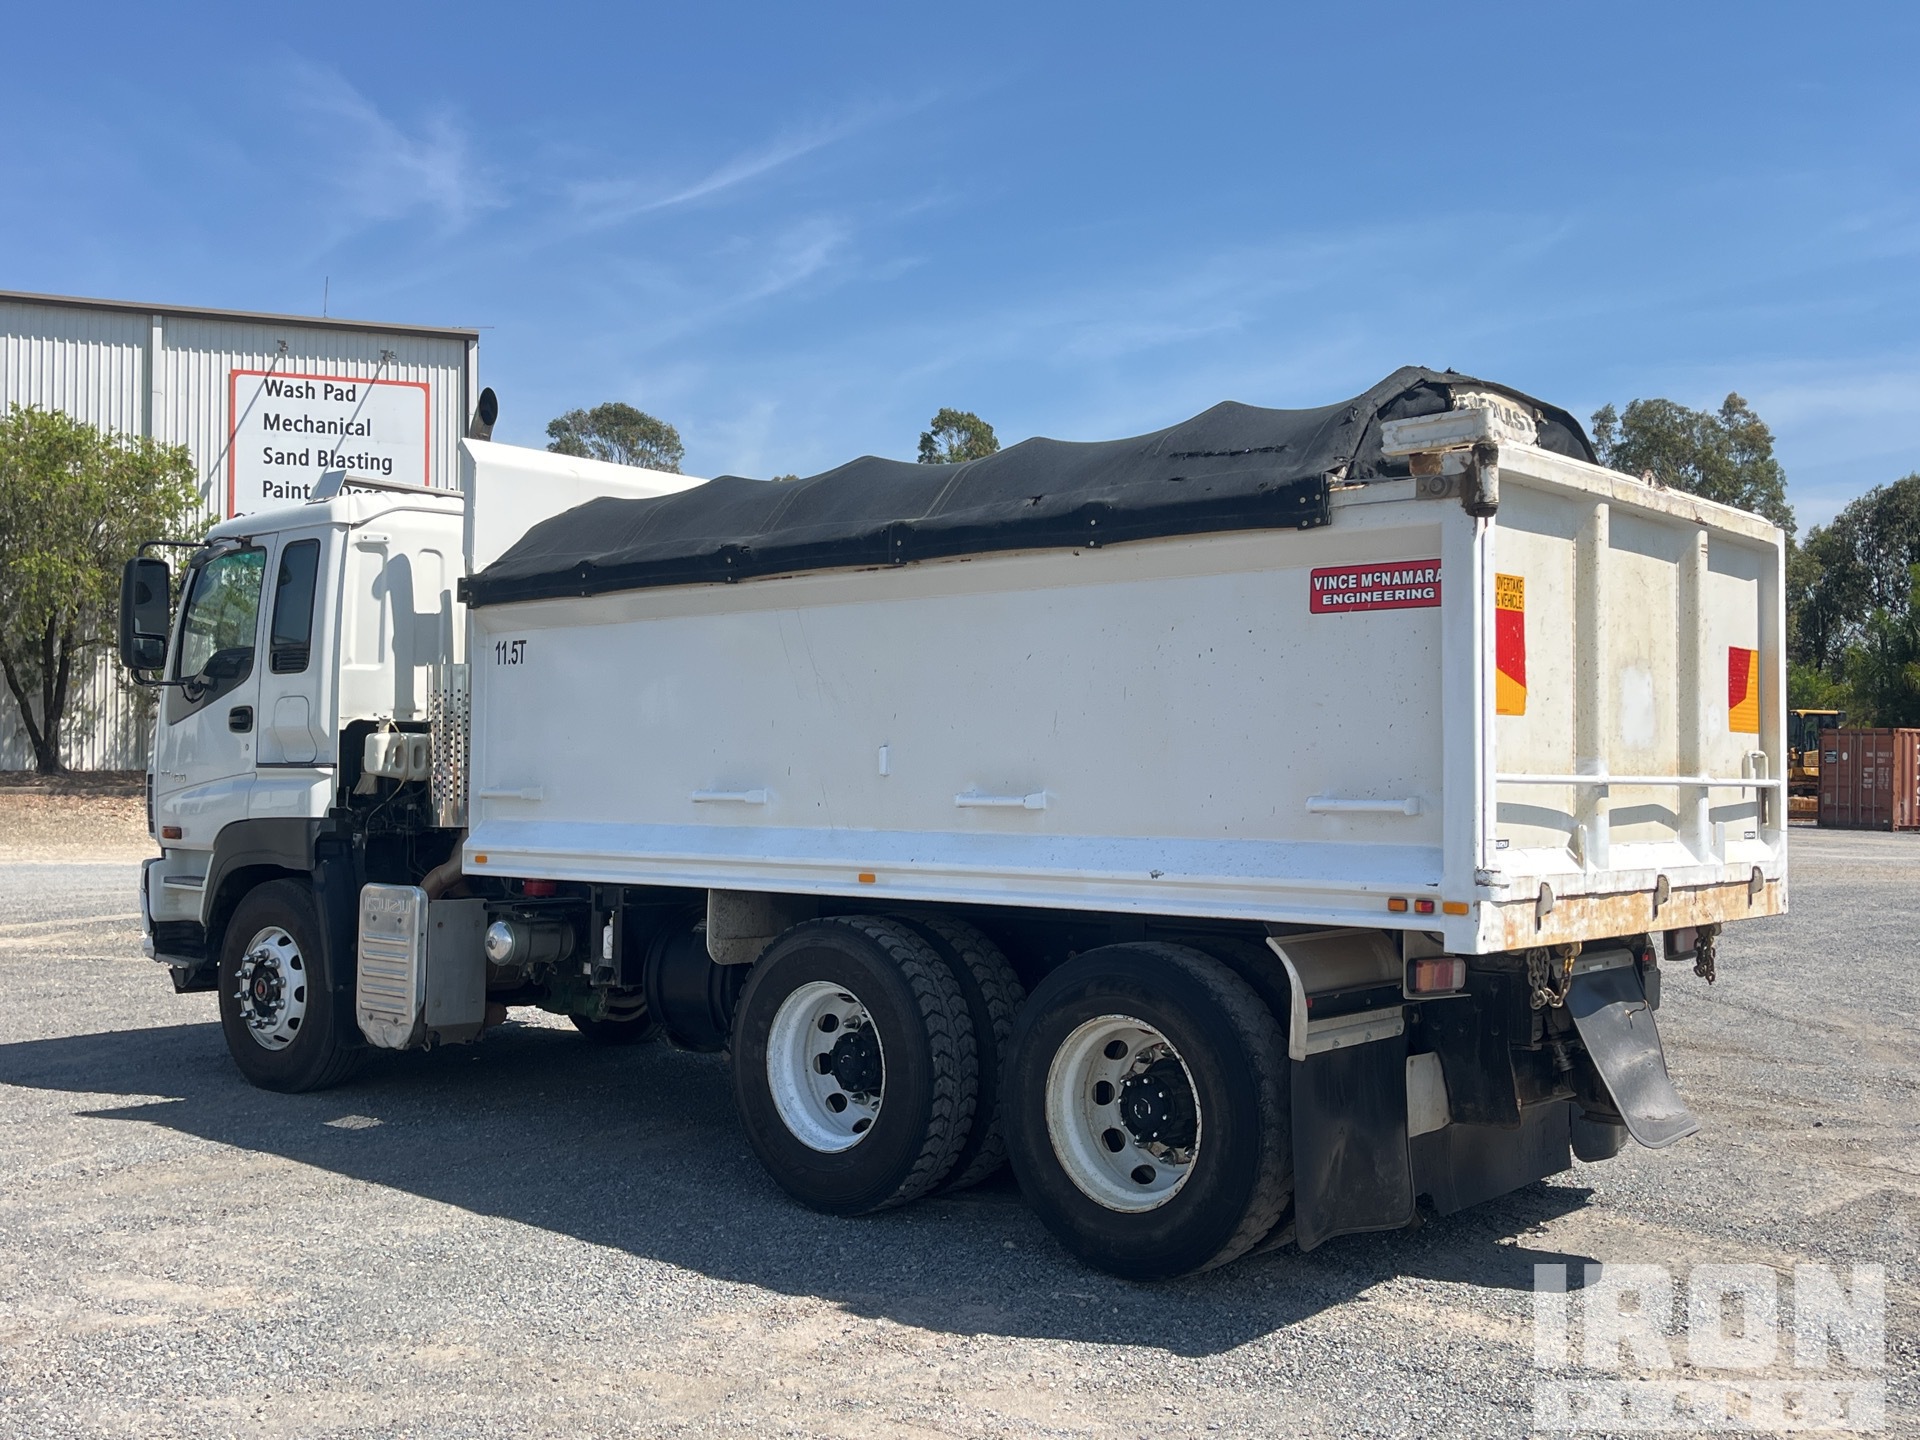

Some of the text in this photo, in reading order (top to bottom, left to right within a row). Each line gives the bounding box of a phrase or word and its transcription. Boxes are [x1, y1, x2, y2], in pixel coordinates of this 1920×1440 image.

[264, 378, 356, 402] Wash Pad
[263, 412, 371, 437] Mechanical
[263, 447, 393, 475] Sand Blasting
[1313, 574, 1358, 592] VINCE
[1496, 575, 1523, 594] OVERTAKE
[1322, 586, 1435, 606] ENGINEERING
[1500, 592, 1523, 609] VEHICLE
[495, 639, 527, 666] 11.5T
